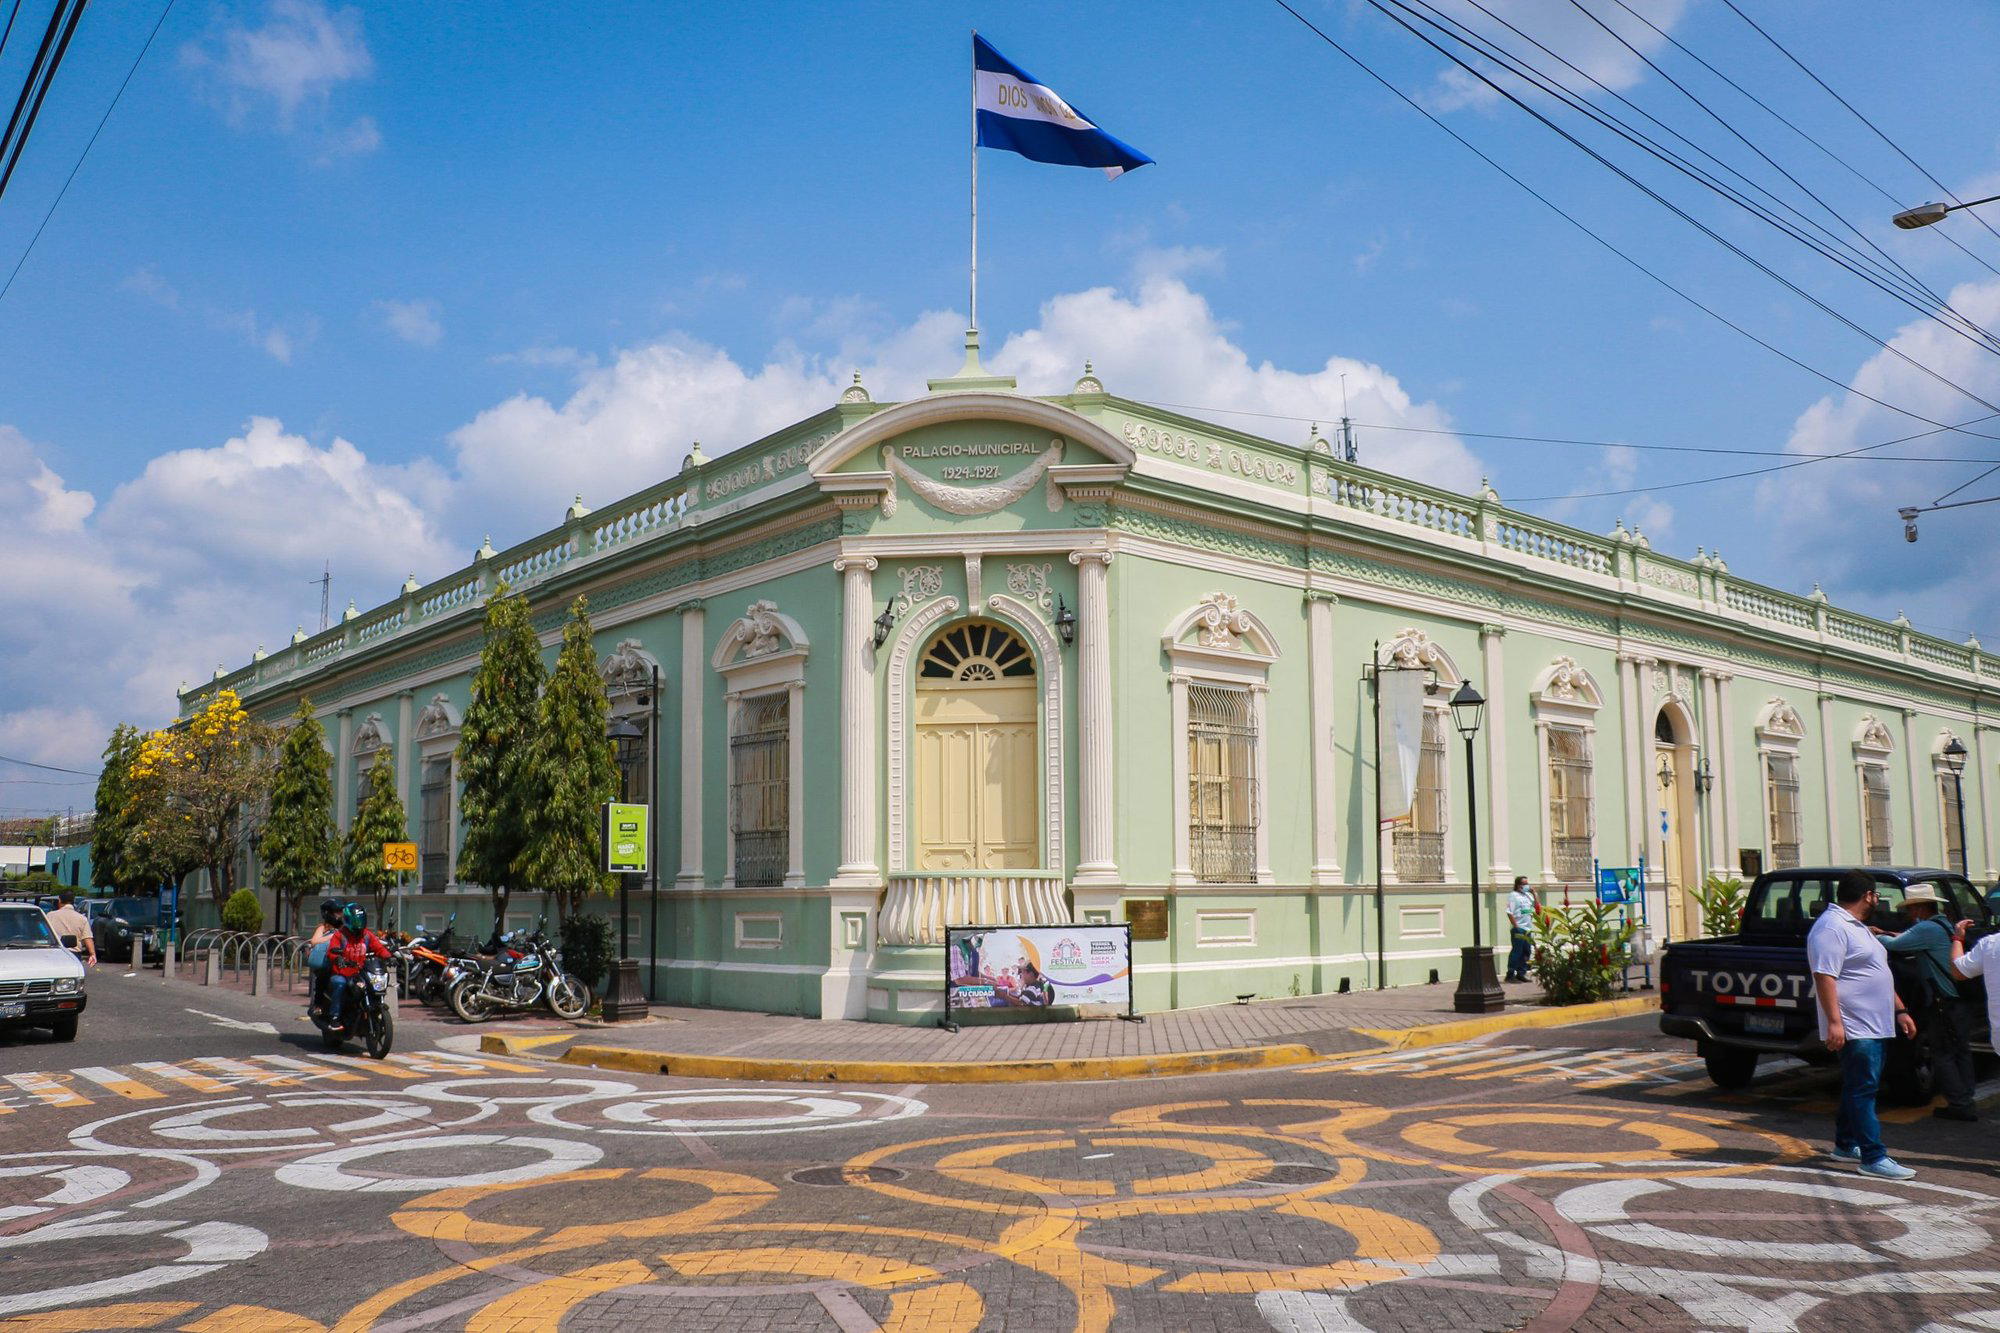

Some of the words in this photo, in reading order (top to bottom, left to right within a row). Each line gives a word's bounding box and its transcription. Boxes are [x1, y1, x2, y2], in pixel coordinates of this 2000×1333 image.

[999, 84, 1028, 109] DIOS
[902, 443, 1041, 458] PALACIO-MUNICIPAL
[1050, 958, 1085, 966] FESTIVAL
